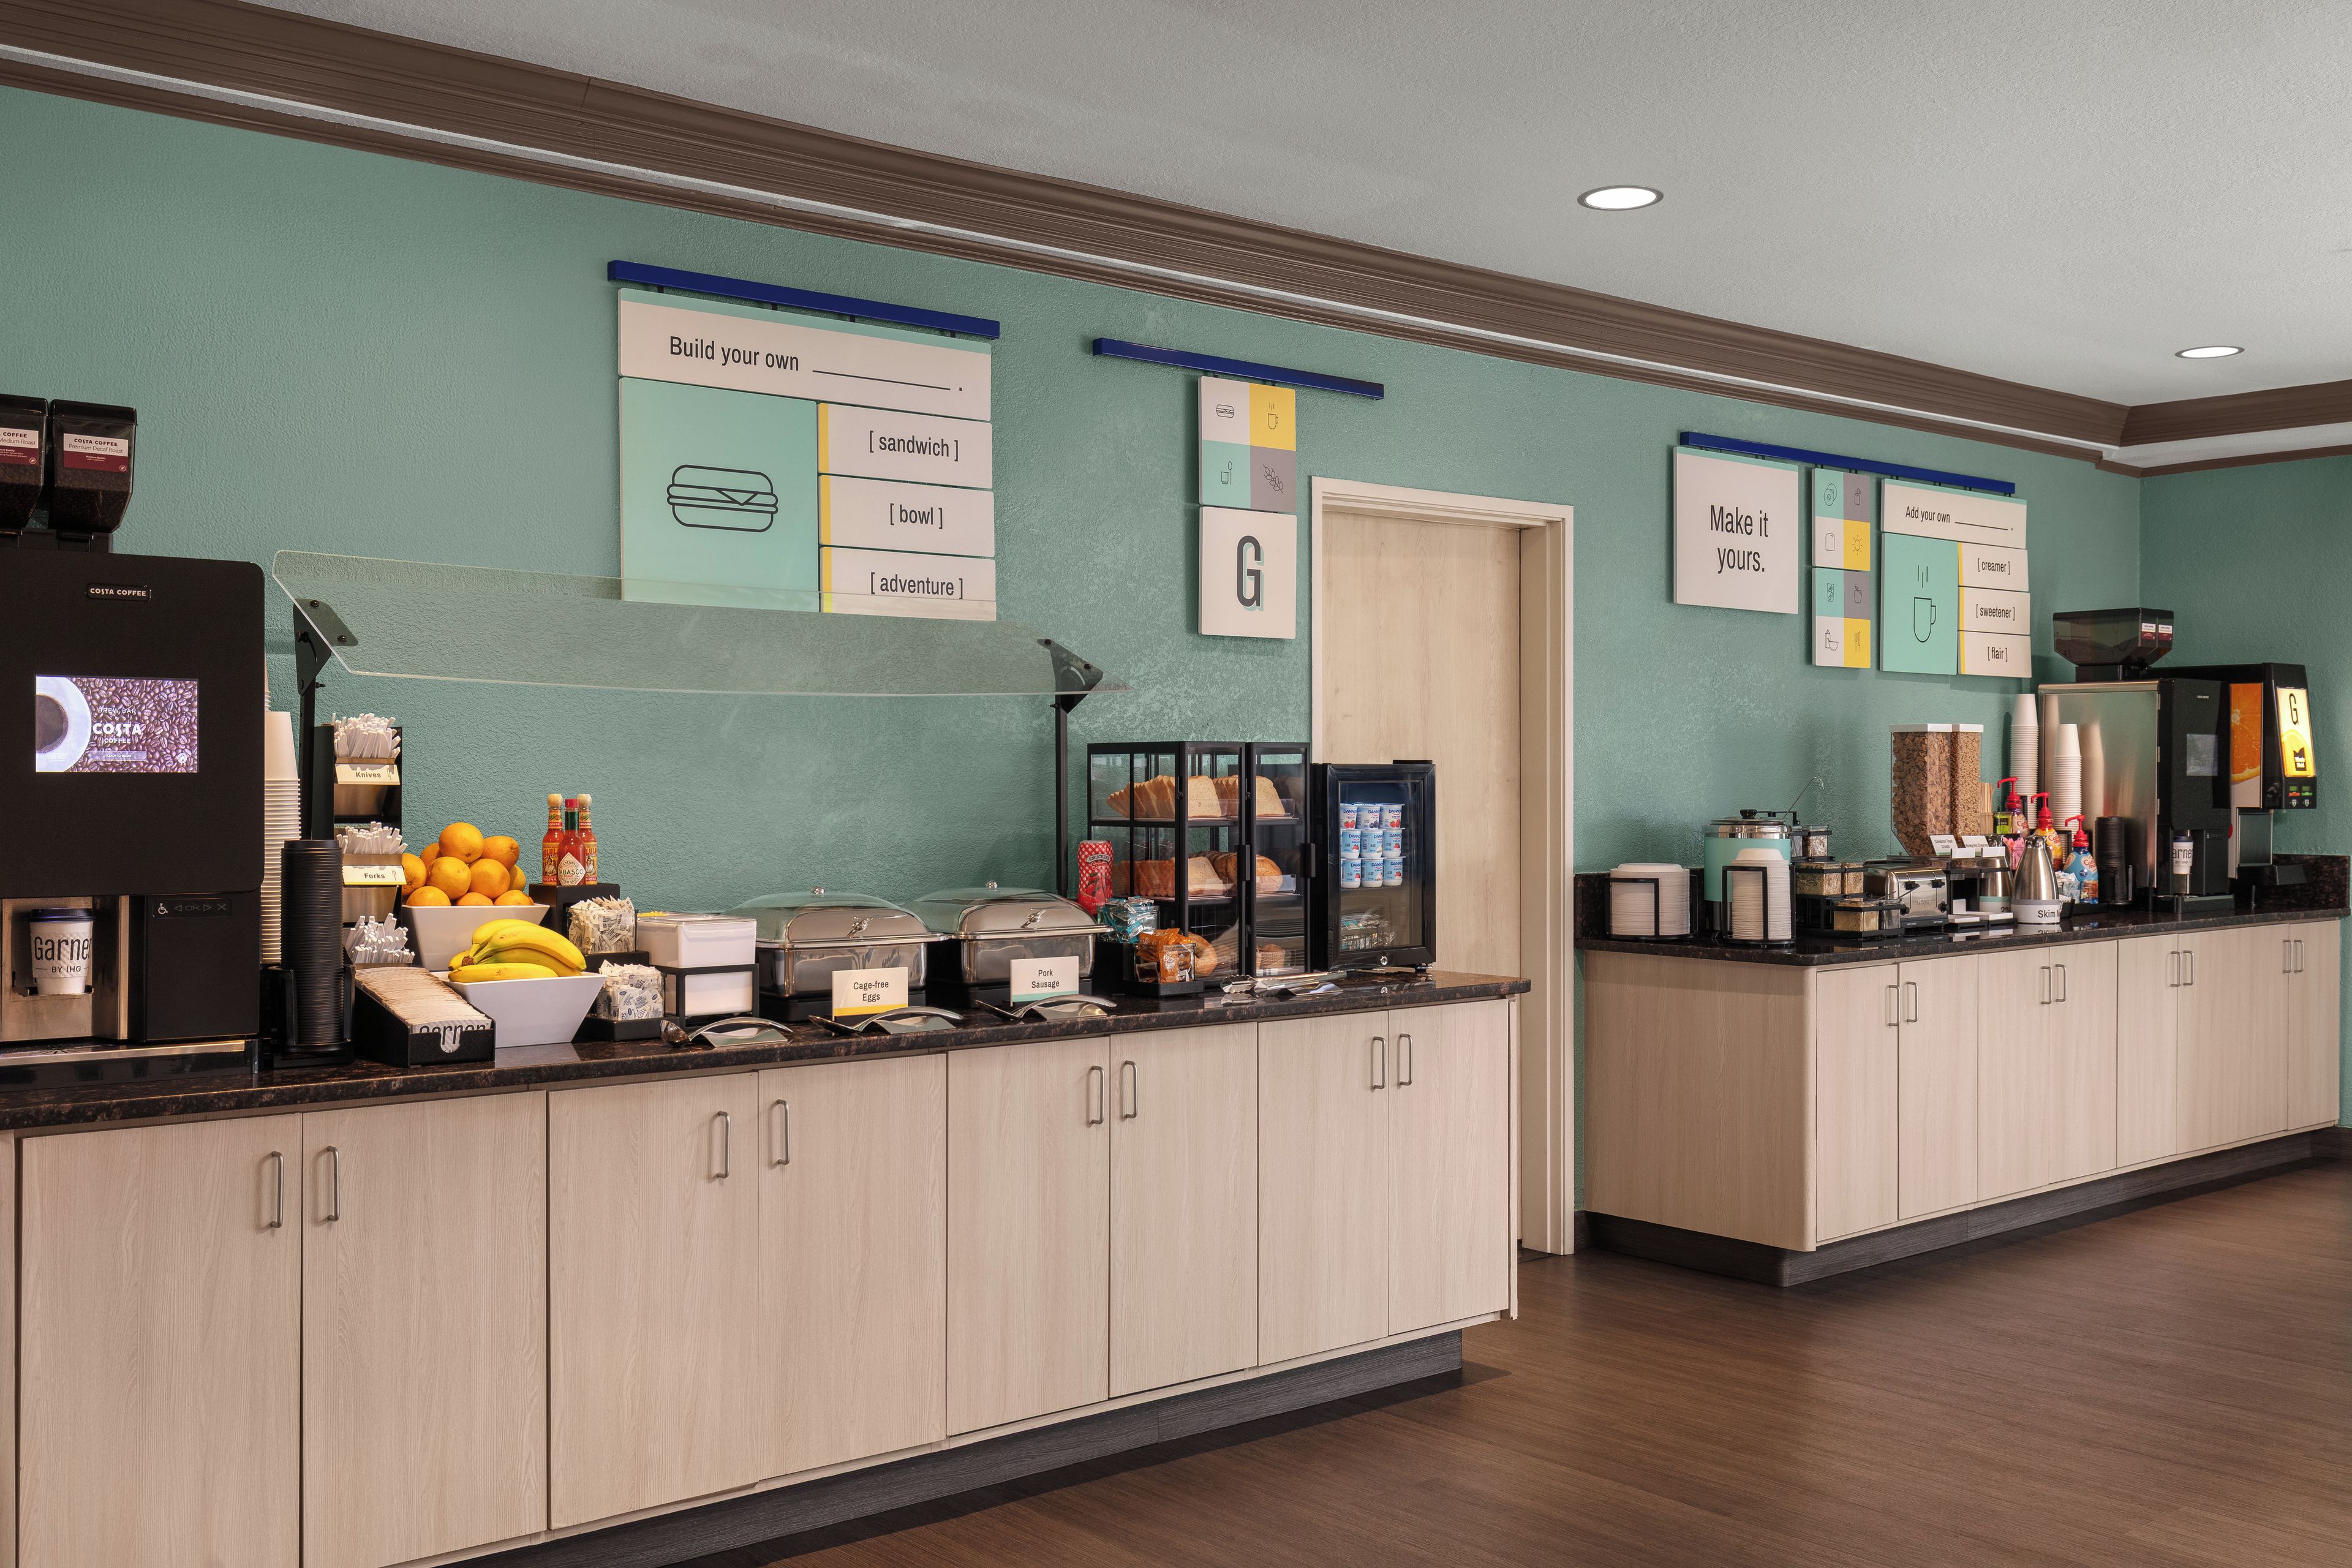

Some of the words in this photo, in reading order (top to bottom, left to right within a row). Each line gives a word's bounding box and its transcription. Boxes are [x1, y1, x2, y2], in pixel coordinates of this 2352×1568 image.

[670, 336, 715, 360] Build
[721, 347, 760, 366] your
[765, 352, 799, 371] own
[1710, 504, 1753, 536] Make
[1760, 510, 1768, 538] it
[1905, 506, 1919, 519] Add
[1921, 510, 1936, 522] your
[1937, 512, 1950, 523] own
[1717, 547, 1765, 574] yours.
[1237, 535, 1263, 610] G
[2289, 693, 2299, 725] G
[92, 723, 143, 737] COSTA
[2173, 849, 2193, 859] arne
[1038, 969, 1053, 978] Pork
[853, 980, 889, 991] Cage-free
[1031, 981, 1060, 989] Sausage
[862, 993, 880, 1003] Eggs
